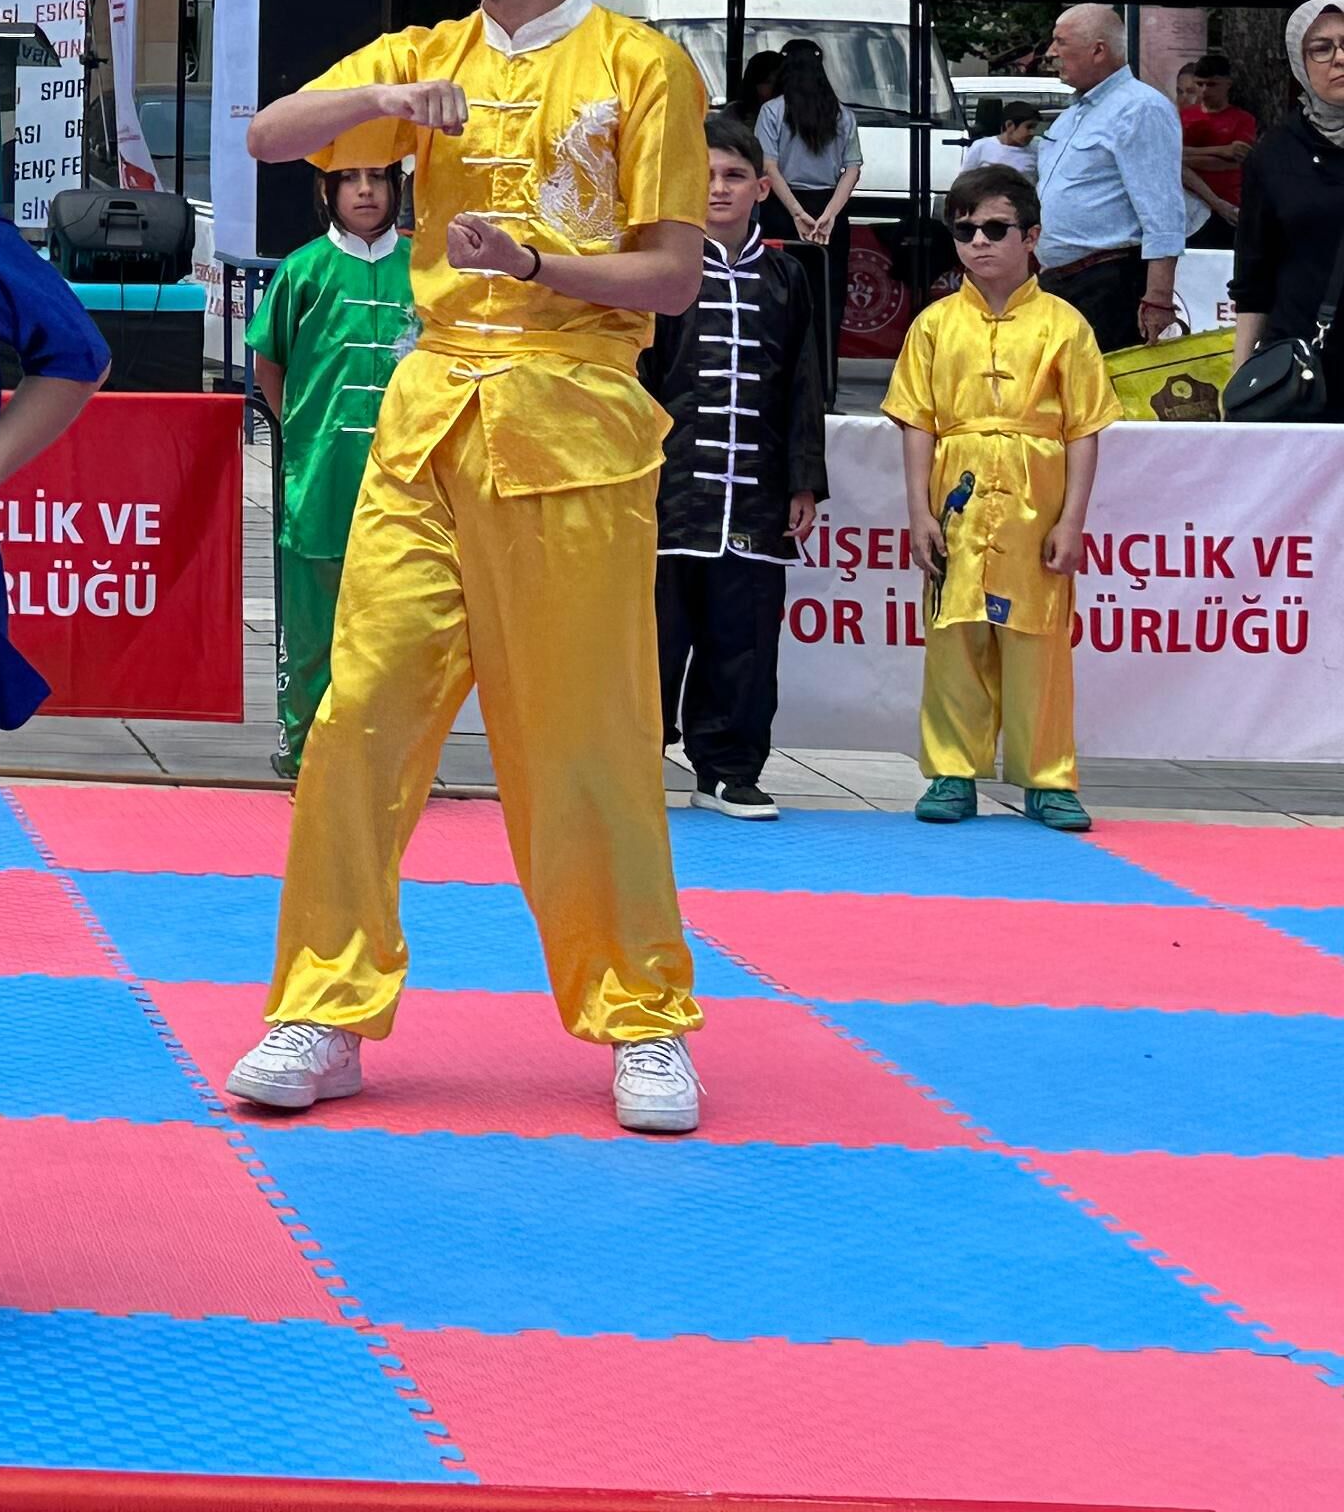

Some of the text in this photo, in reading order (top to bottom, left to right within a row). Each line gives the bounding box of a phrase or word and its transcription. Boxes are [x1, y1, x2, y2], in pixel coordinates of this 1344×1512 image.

[97, 502, 161, 546] VE
[1078, 521, 1236, 591] NÇLİK
[1252, 535, 1314, 579] VE
[1071, 592, 1310, 655] ÜRLÜĞÜ
